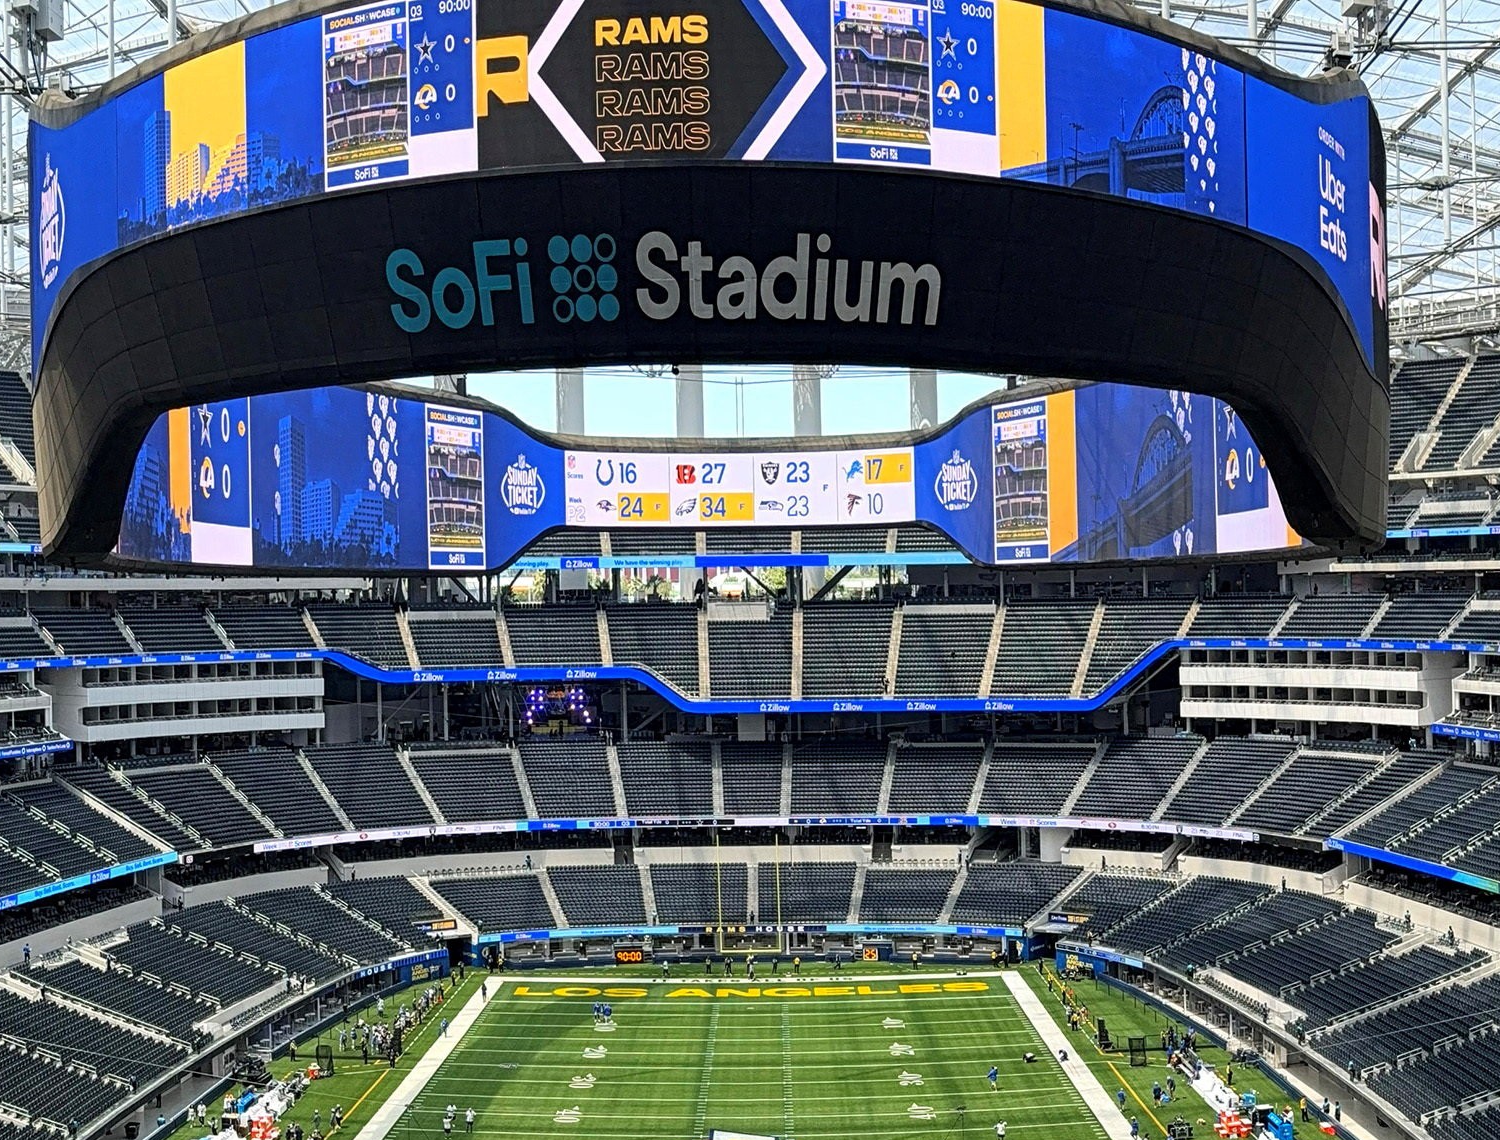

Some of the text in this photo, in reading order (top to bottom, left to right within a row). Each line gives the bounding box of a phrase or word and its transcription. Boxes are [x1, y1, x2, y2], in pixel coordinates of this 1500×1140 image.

[410, 5, 423, 16] Q3
[961, 3, 993, 19] 90:00
[595, 15, 709, 46] RAMS
[444, 34, 455, 53] 0
[967, 38, 977, 55] 0
[595, 51, 710, 82] RAMS
[445, 84, 456, 102] 0
[596, 86, 710, 117] RAMS
[969, 86, 979, 104] 0
[597, 122, 711, 152] RAMS
[870, 147, 888, 160] SoFi
[355, 169, 370, 180] SoFi
[1319, 154, 1346, 213] Uber
[1320, 205, 1347, 262] Eats
[385, 230, 942, 333] SoFi Stadium
[221, 407, 230, 443] 0
[619, 463, 637, 484] 16
[702, 463, 726, 484] 27
[786, 461, 810, 483] 23
[867, 459, 883, 480] 17
[942, 460, 971, 481] SUNDAY
[1246, 447, 1254, 483] 0
[222, 464, 231, 499] 0
[507, 465, 538, 486] SUNDAY
[567, 472, 583, 480] Scores
[507, 486, 538, 507] TICKET
[823, 484, 829, 492] F
[942, 481, 971, 503] TICKET
[620, 497, 643, 518] 24
[702, 497, 726, 517] 34
[787, 495, 810, 517] 23
[868, 493, 884, 515] 10
[567, 506, 586, 523] P2
[572, 558, 593, 568] Zillow
[421, 673, 444, 682] Zillow
[494, 672, 518, 681] Zillow
[574, 670, 598, 679] Zillow
[766, 703, 791, 712] Zillow
[840, 702, 864, 711] Zillow
[914, 701, 938, 710] Zillow
[991, 701, 1015, 710] Zillow
[616, 951, 642, 962] 90:00
[360, 963, 393, 977] HOUSE
[514, 982, 990, 998] LOS ANGELES
[553, 1108, 583, 1124] 40
[907, 1105, 936, 1120] 40
